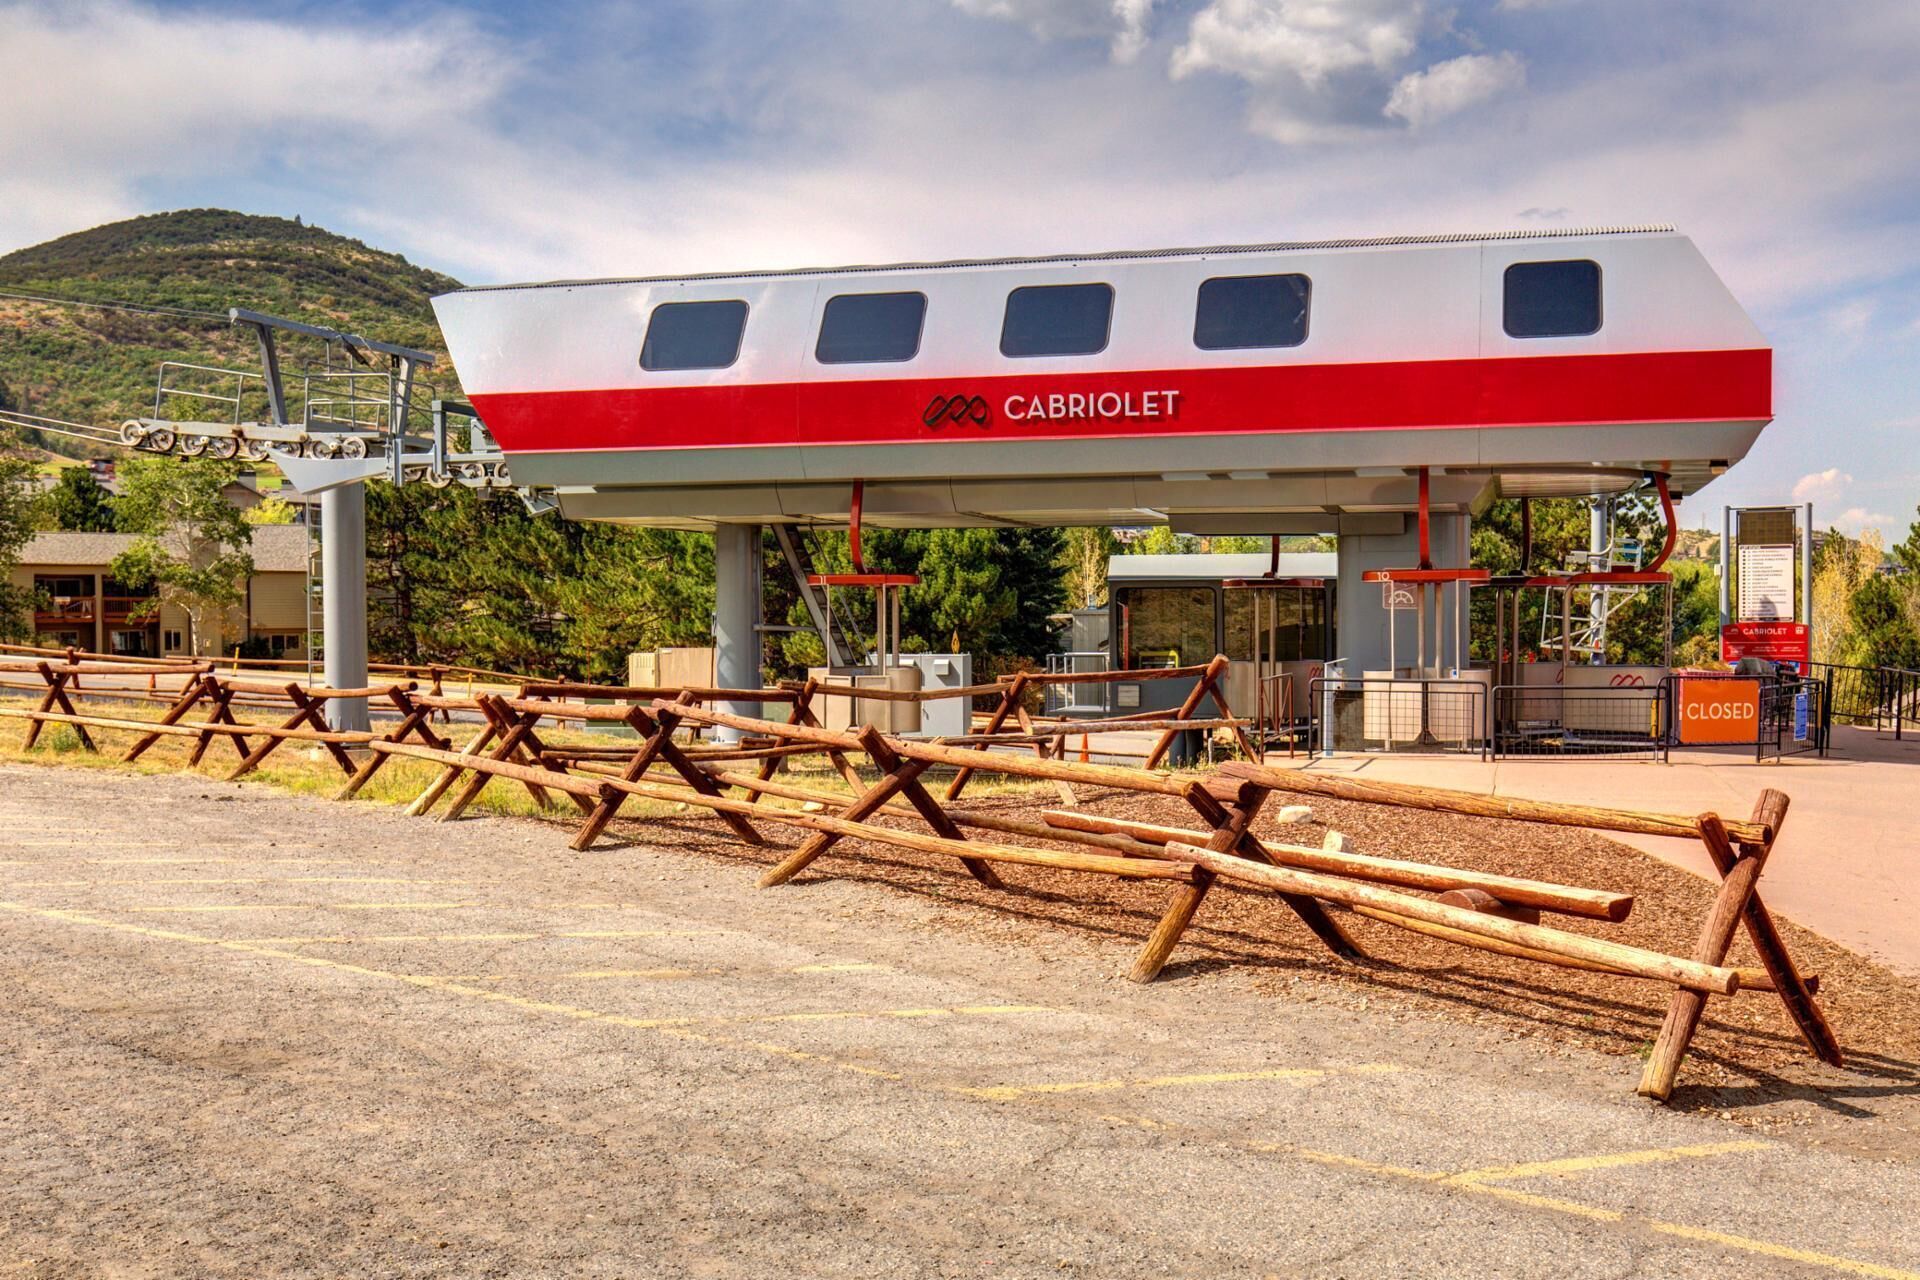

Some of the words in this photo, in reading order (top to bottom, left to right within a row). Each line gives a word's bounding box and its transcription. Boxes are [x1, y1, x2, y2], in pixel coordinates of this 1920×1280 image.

[1004, 390, 1180, 420] CABRIOLET
[1376, 571, 1390, 581] 10
[1742, 627, 1788, 636] CABRIOLET
[1686, 702, 1755, 720] CLOSED
